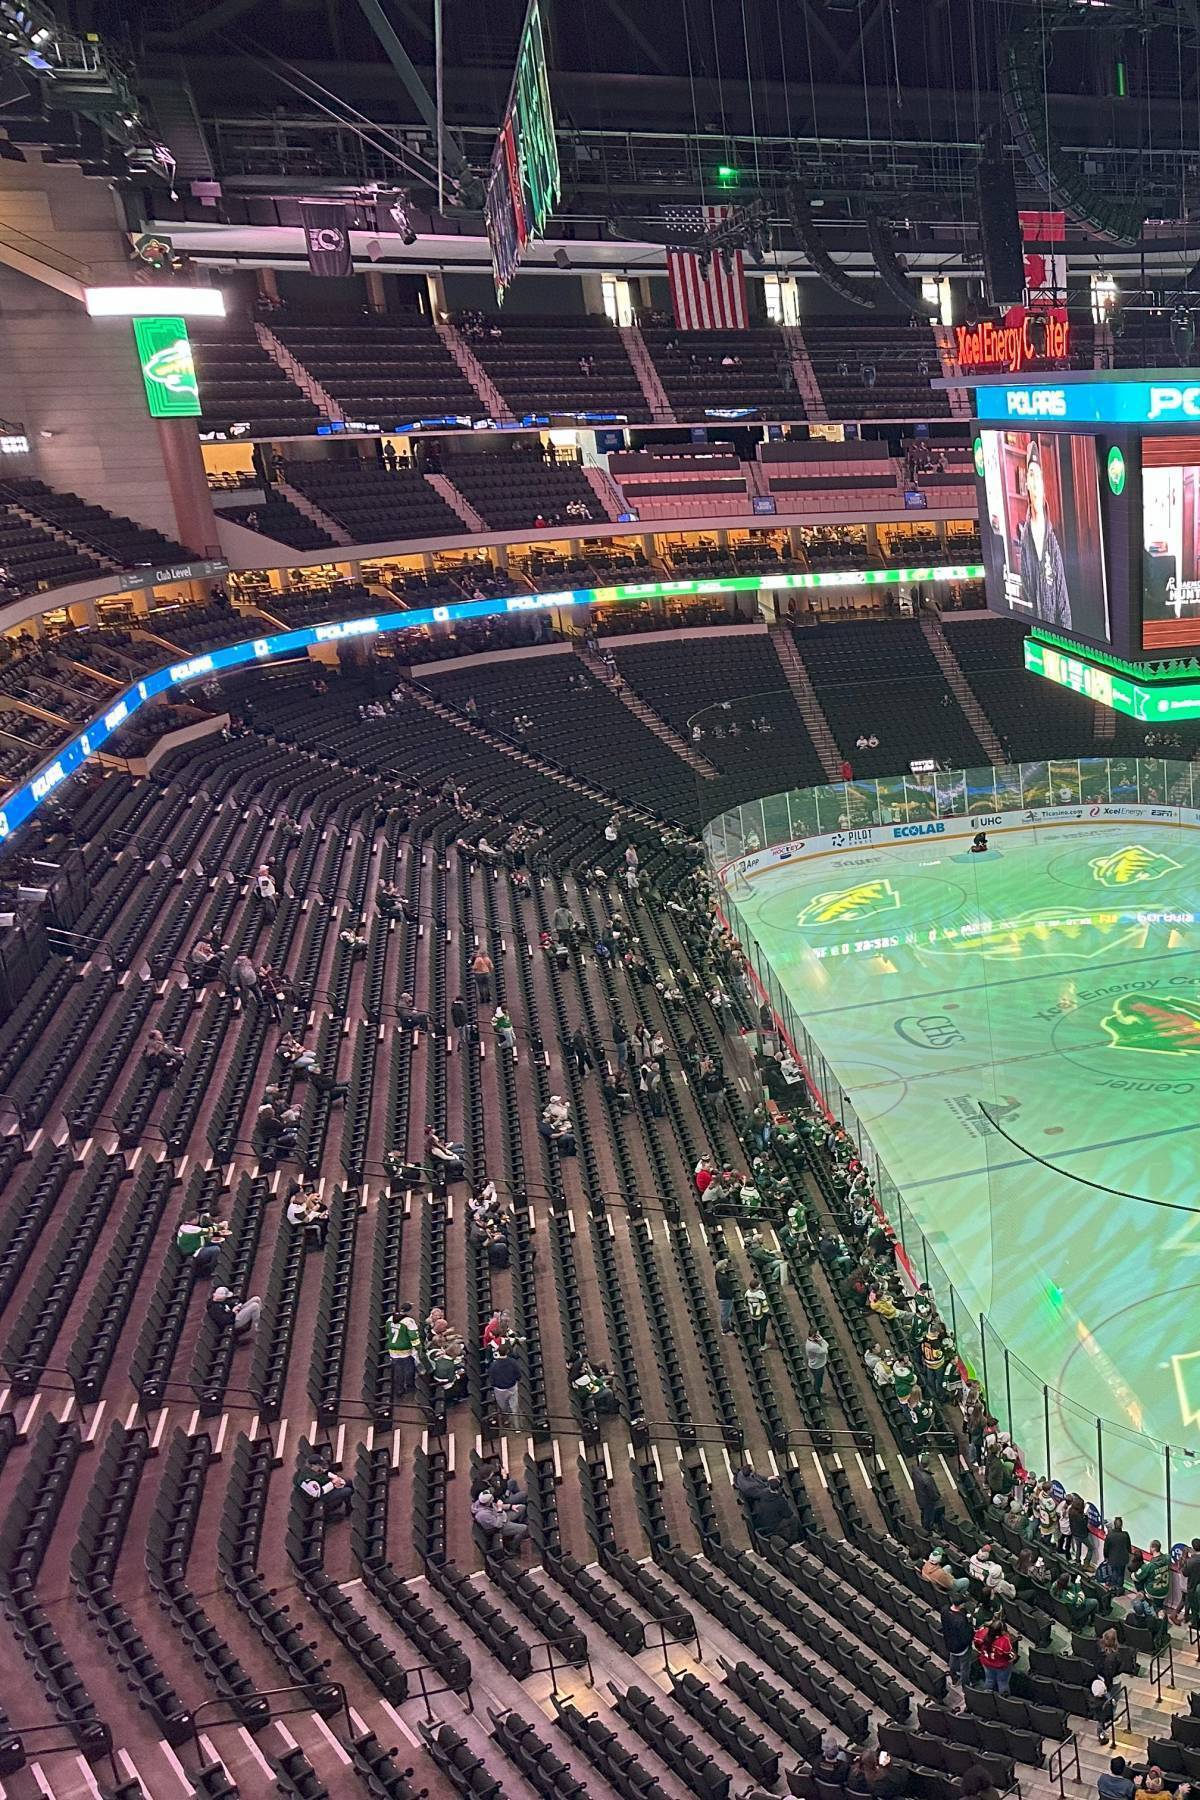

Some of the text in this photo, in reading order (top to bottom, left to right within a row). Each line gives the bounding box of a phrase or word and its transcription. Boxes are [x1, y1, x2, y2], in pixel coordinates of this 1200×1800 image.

[956, 315, 1069, 372] Xcel Energy Cnter
[1006, 390, 1067, 416] POLARIS
[156, 569, 172, 581] Club
[171, 566, 192, 579] Level
[980, 816, 1002, 826] UHC
[848, 829, 872, 841] PILOT
[893, 822, 946, 838] ECOLAB
[1077, 980, 1160, 1001] Energy
[916, 1016, 967, 1046] CHS
[1096, 1079, 1195, 1095] Center
